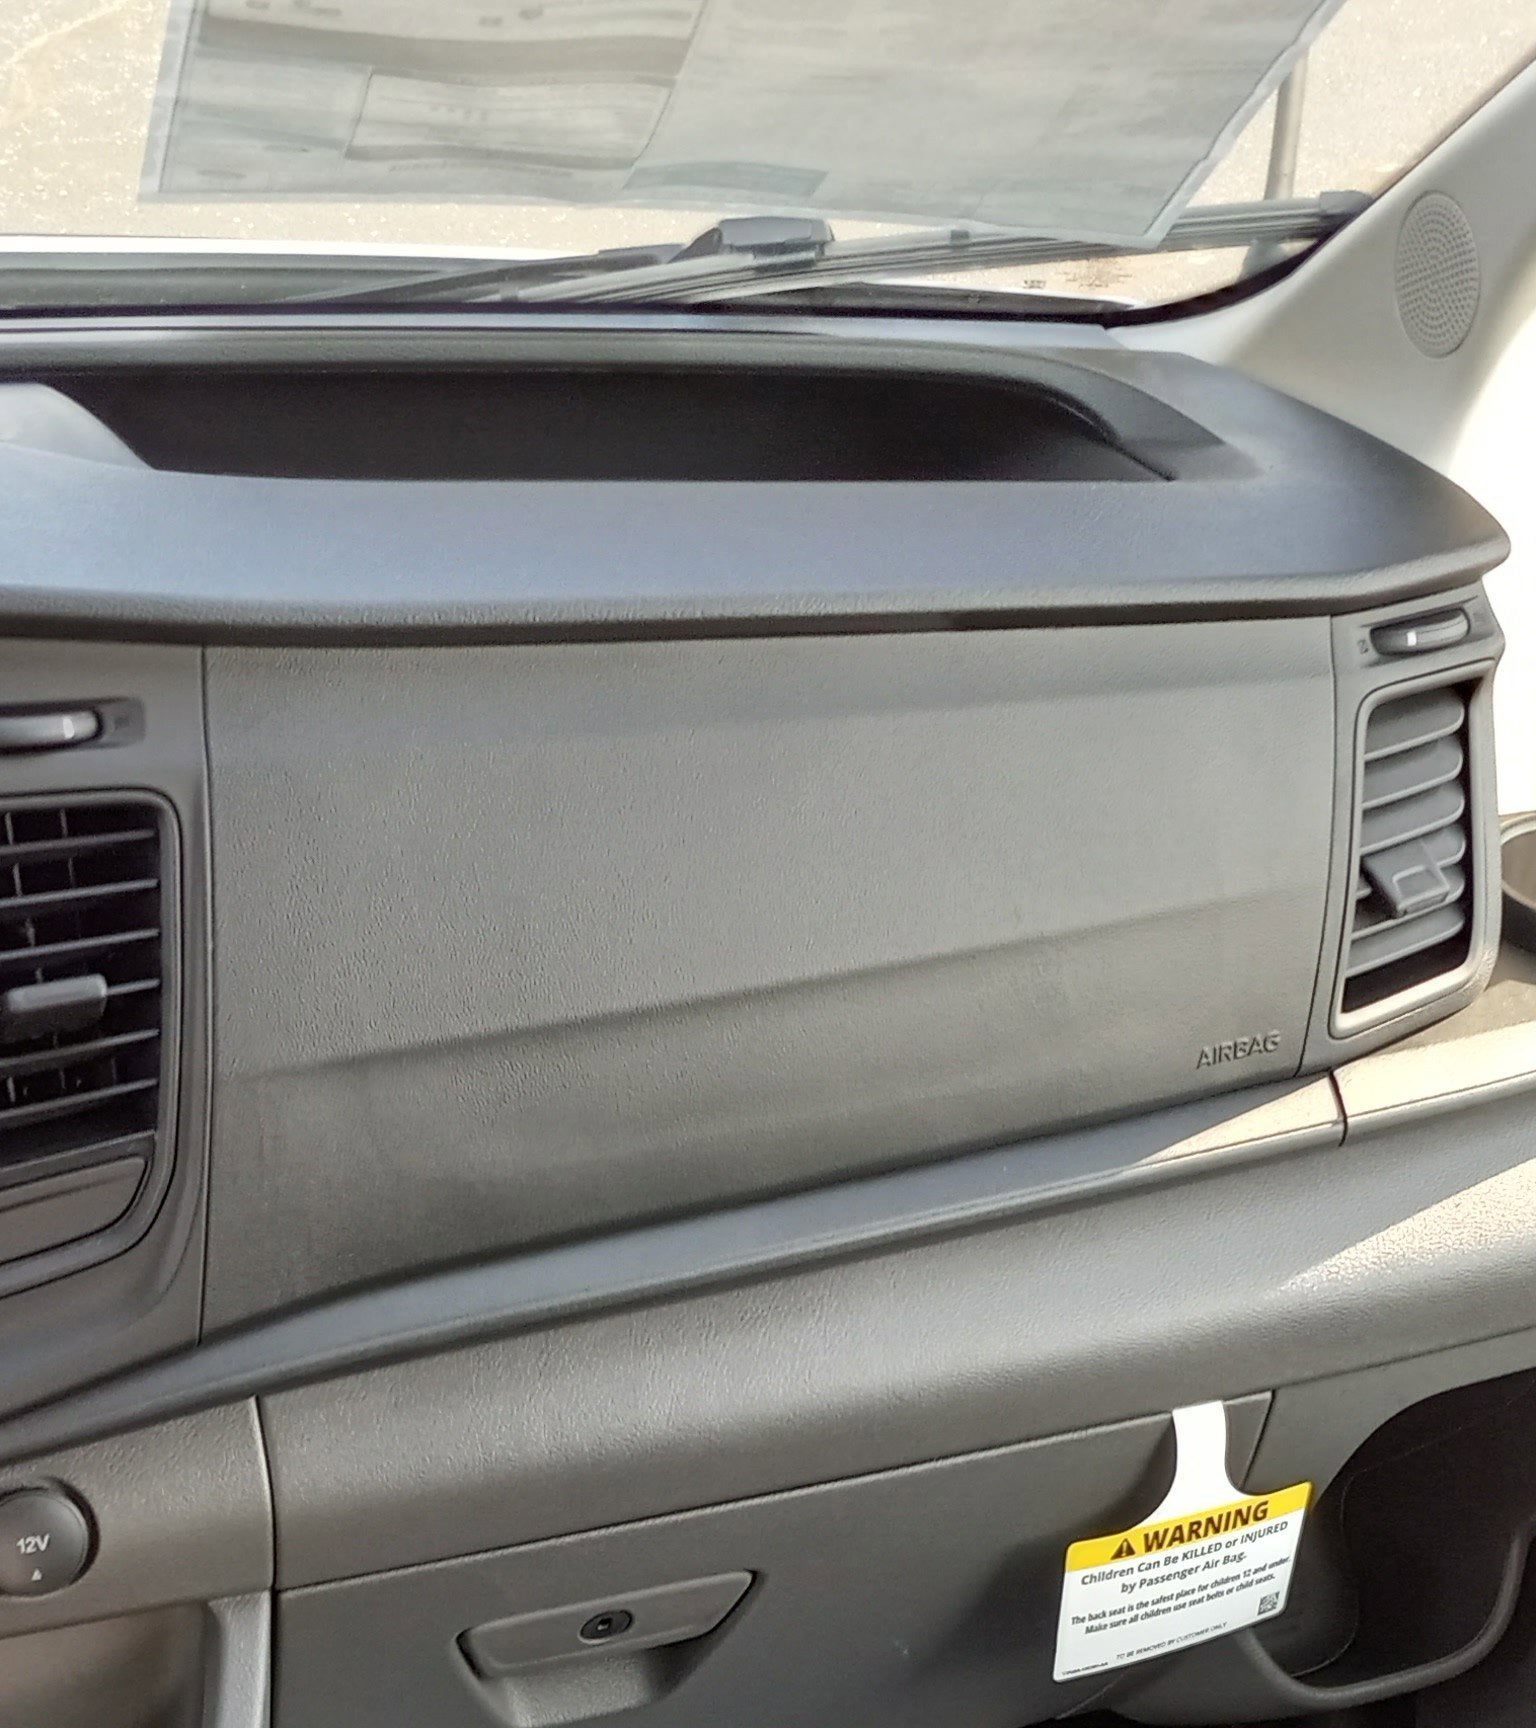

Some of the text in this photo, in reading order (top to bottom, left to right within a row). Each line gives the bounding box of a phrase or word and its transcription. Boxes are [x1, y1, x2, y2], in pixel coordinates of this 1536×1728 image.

[1196, 1029, 1281, 1069] AIRBAG
[16, 1533, 50, 1554] 12V
[1081, 1521, 1288, 1585] Children Can Be KILLED or INJURED
[1143, 1501, 1269, 1553] WARNING
[1071, 1615, 1086, 1625] The
[1088, 1610, 1107, 1622] back
[1109, 1606, 1126, 1617] seat
[1127, 1603, 1134, 1612] is
[1136, 1599, 1149, 1611] the
[1151, 1594, 1174, 1608] safest
[1175, 1587, 1196, 1601] place
[1198, 1584, 1209, 1595] for
[1210, 1574, 1241, 1589] children
[1242, 1569, 1252, 1579] 12
[1252, 1564, 1267, 1575] and
[1121, 1582, 1137, 1594] by
[1139, 1565, 1201, 1589] Passenger
[1202, 1559, 1220, 1571] Air
[1085, 1623, 1108, 1634] Make
[1109, 1618, 1127, 1629] sure
[1129, 1614, 1139, 1624] all
[1140, 1607, 1172, 1621] children
[1173, 1602, 1186, 1612] use
[1188, 1593, 1205, 1607] seat
[1226, 1587, 1234, 1595] or
[1235, 1578, 1254, 1592] child
